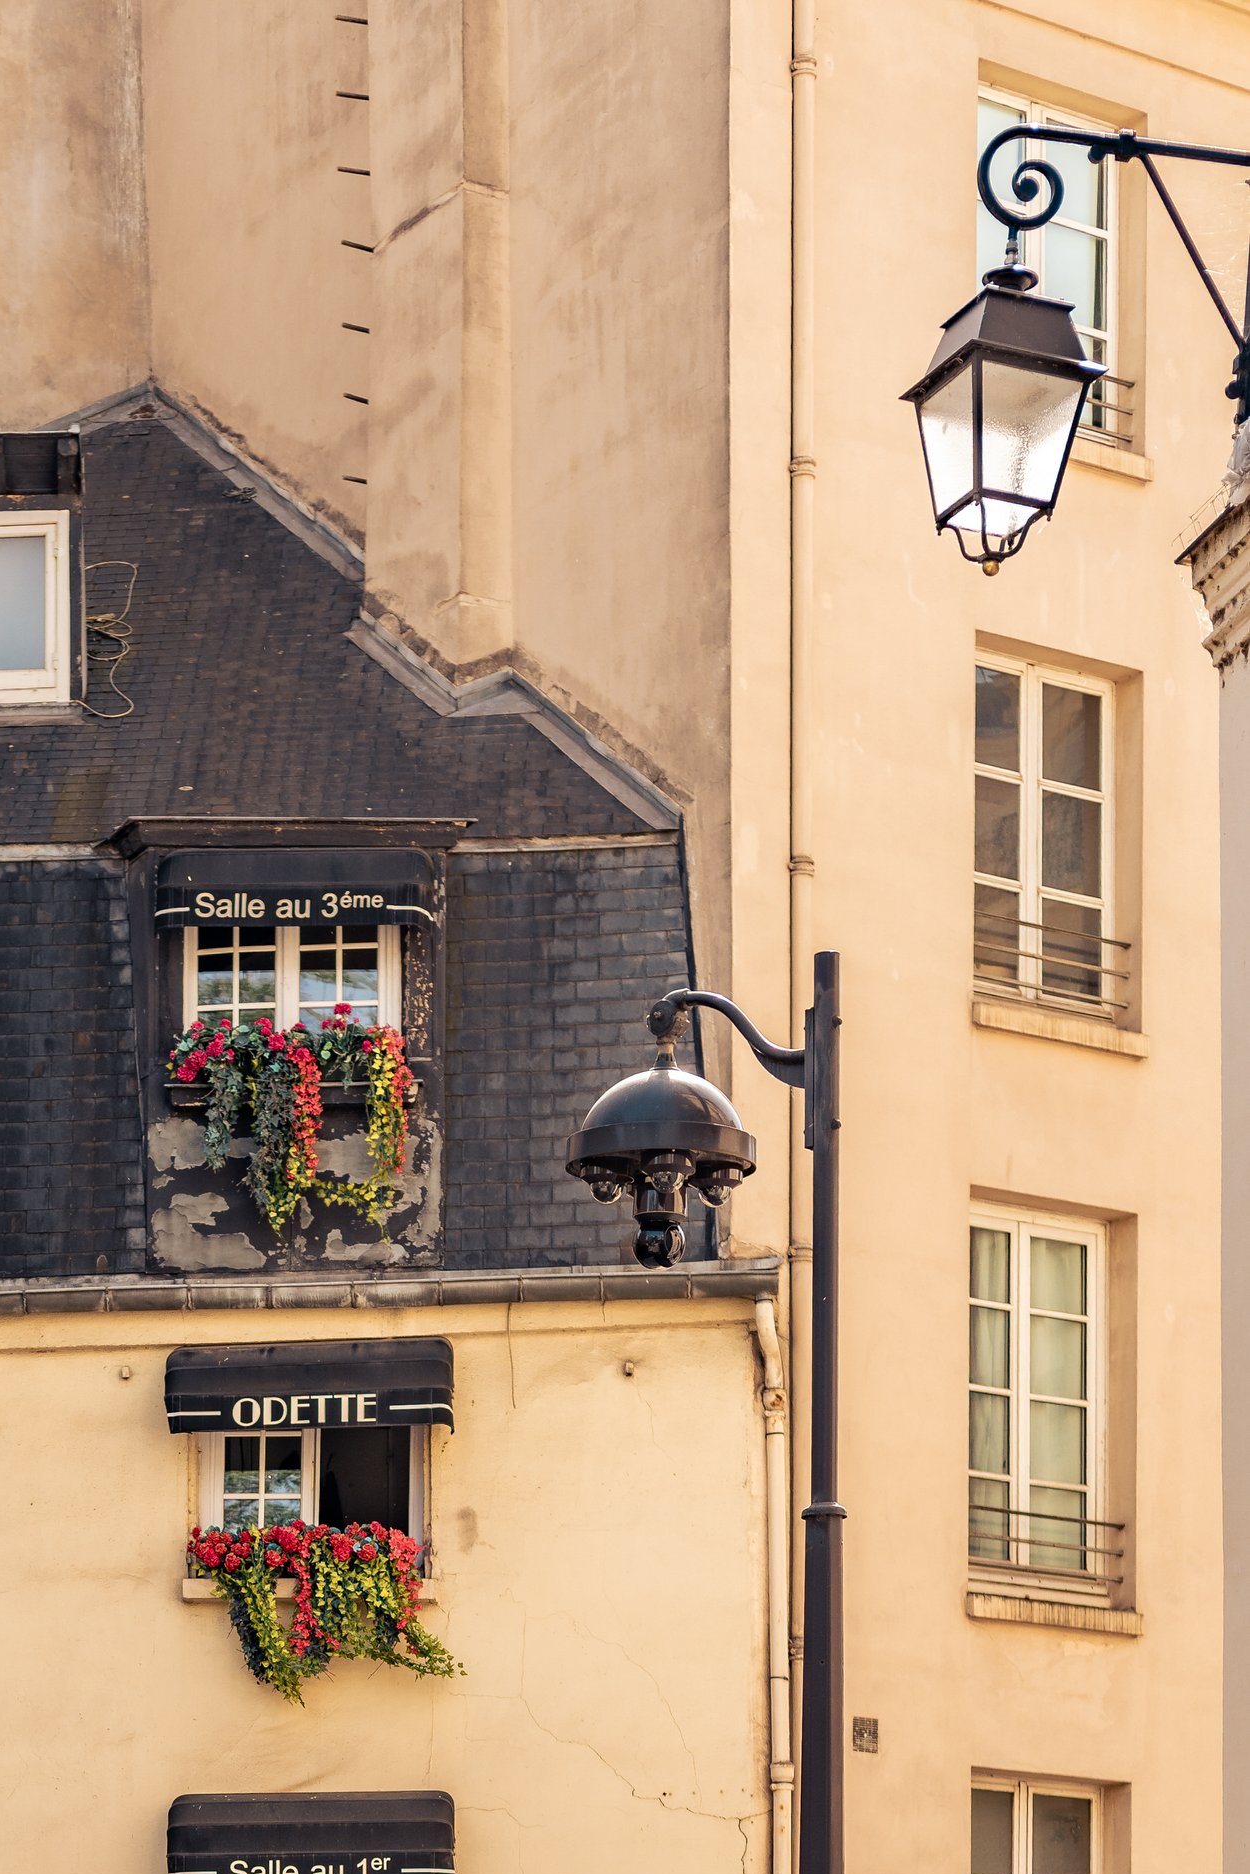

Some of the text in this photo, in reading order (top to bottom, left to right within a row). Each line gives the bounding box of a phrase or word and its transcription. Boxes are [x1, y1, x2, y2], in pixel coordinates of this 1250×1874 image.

[194, 891, 384, 918] Salle au 3éme
[232, 1393, 377, 1427] ODETTE
